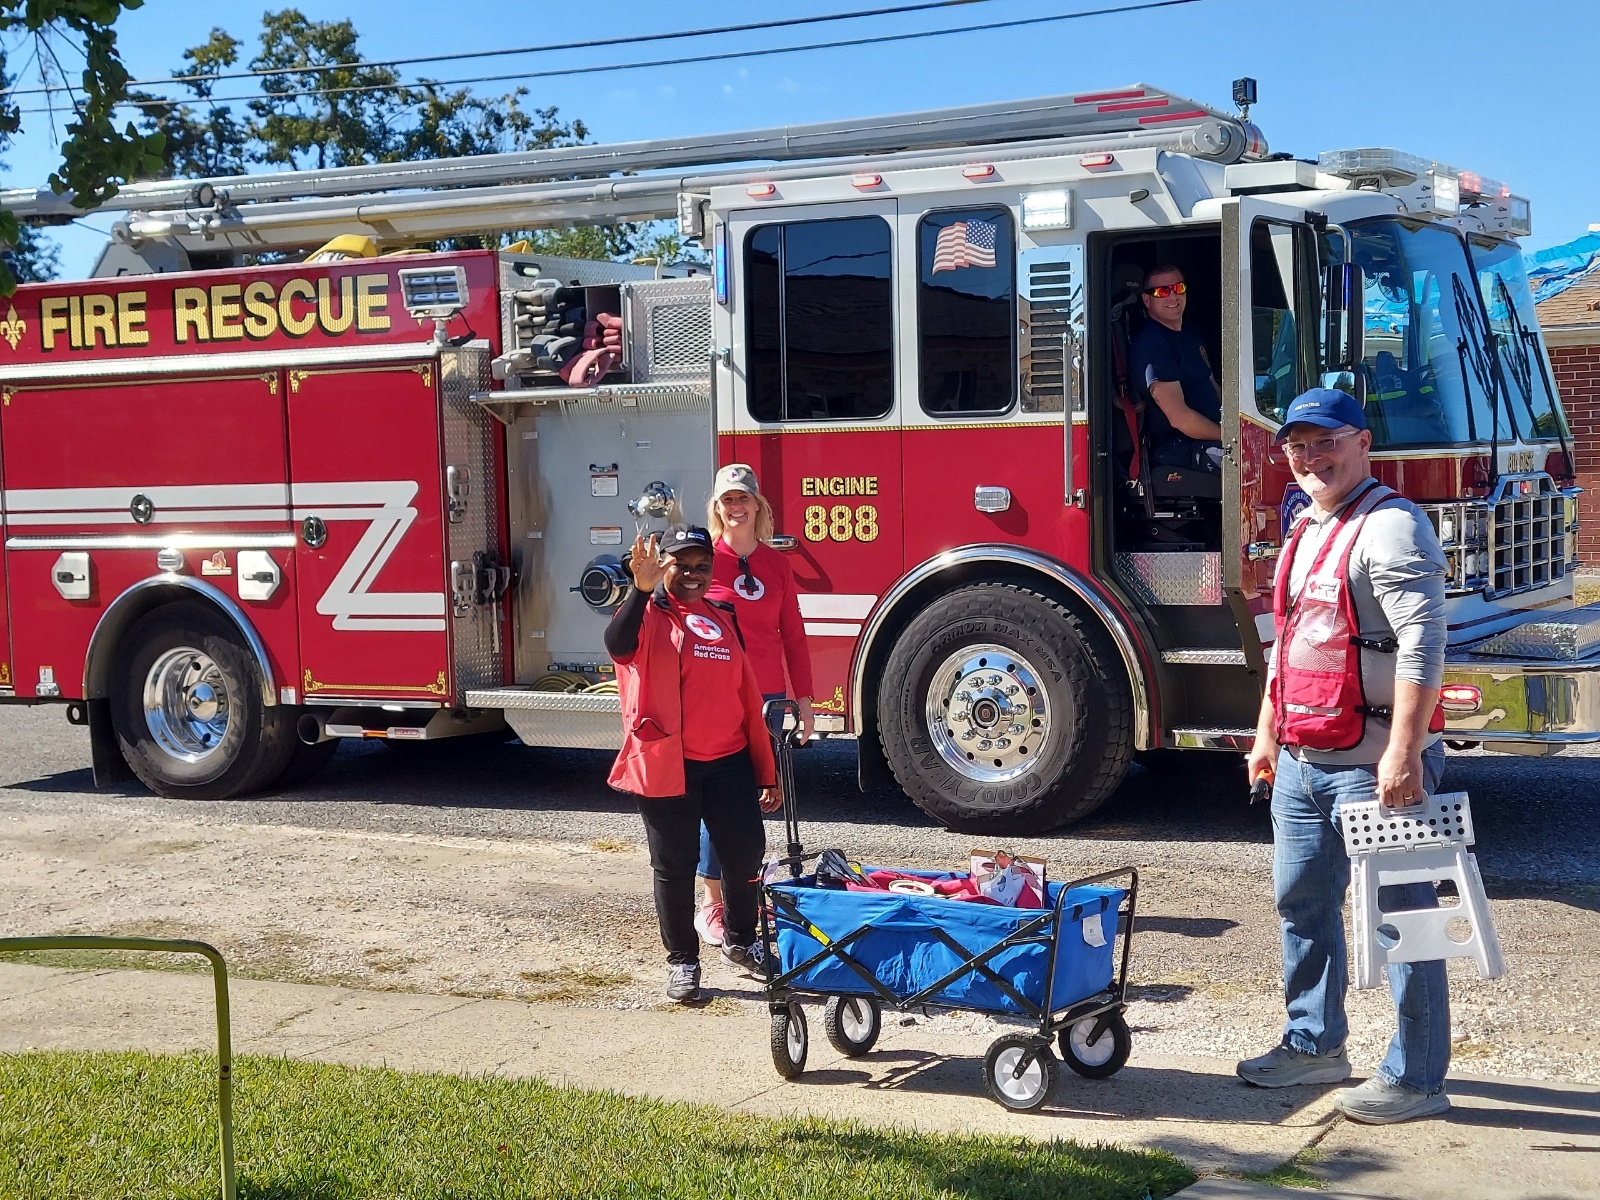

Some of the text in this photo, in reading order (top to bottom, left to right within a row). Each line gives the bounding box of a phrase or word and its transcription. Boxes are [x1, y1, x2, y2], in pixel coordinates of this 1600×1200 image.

[41, 273, 391, 350] FIRE RESCUE
[802, 477, 879, 497] ENGINE
[804, 505, 879, 542] 888
[693, 644, 730, 654] American
[694, 650, 731, 661] Red Cross
[930, 621, 1063, 684] ARMOR MAX MSA
